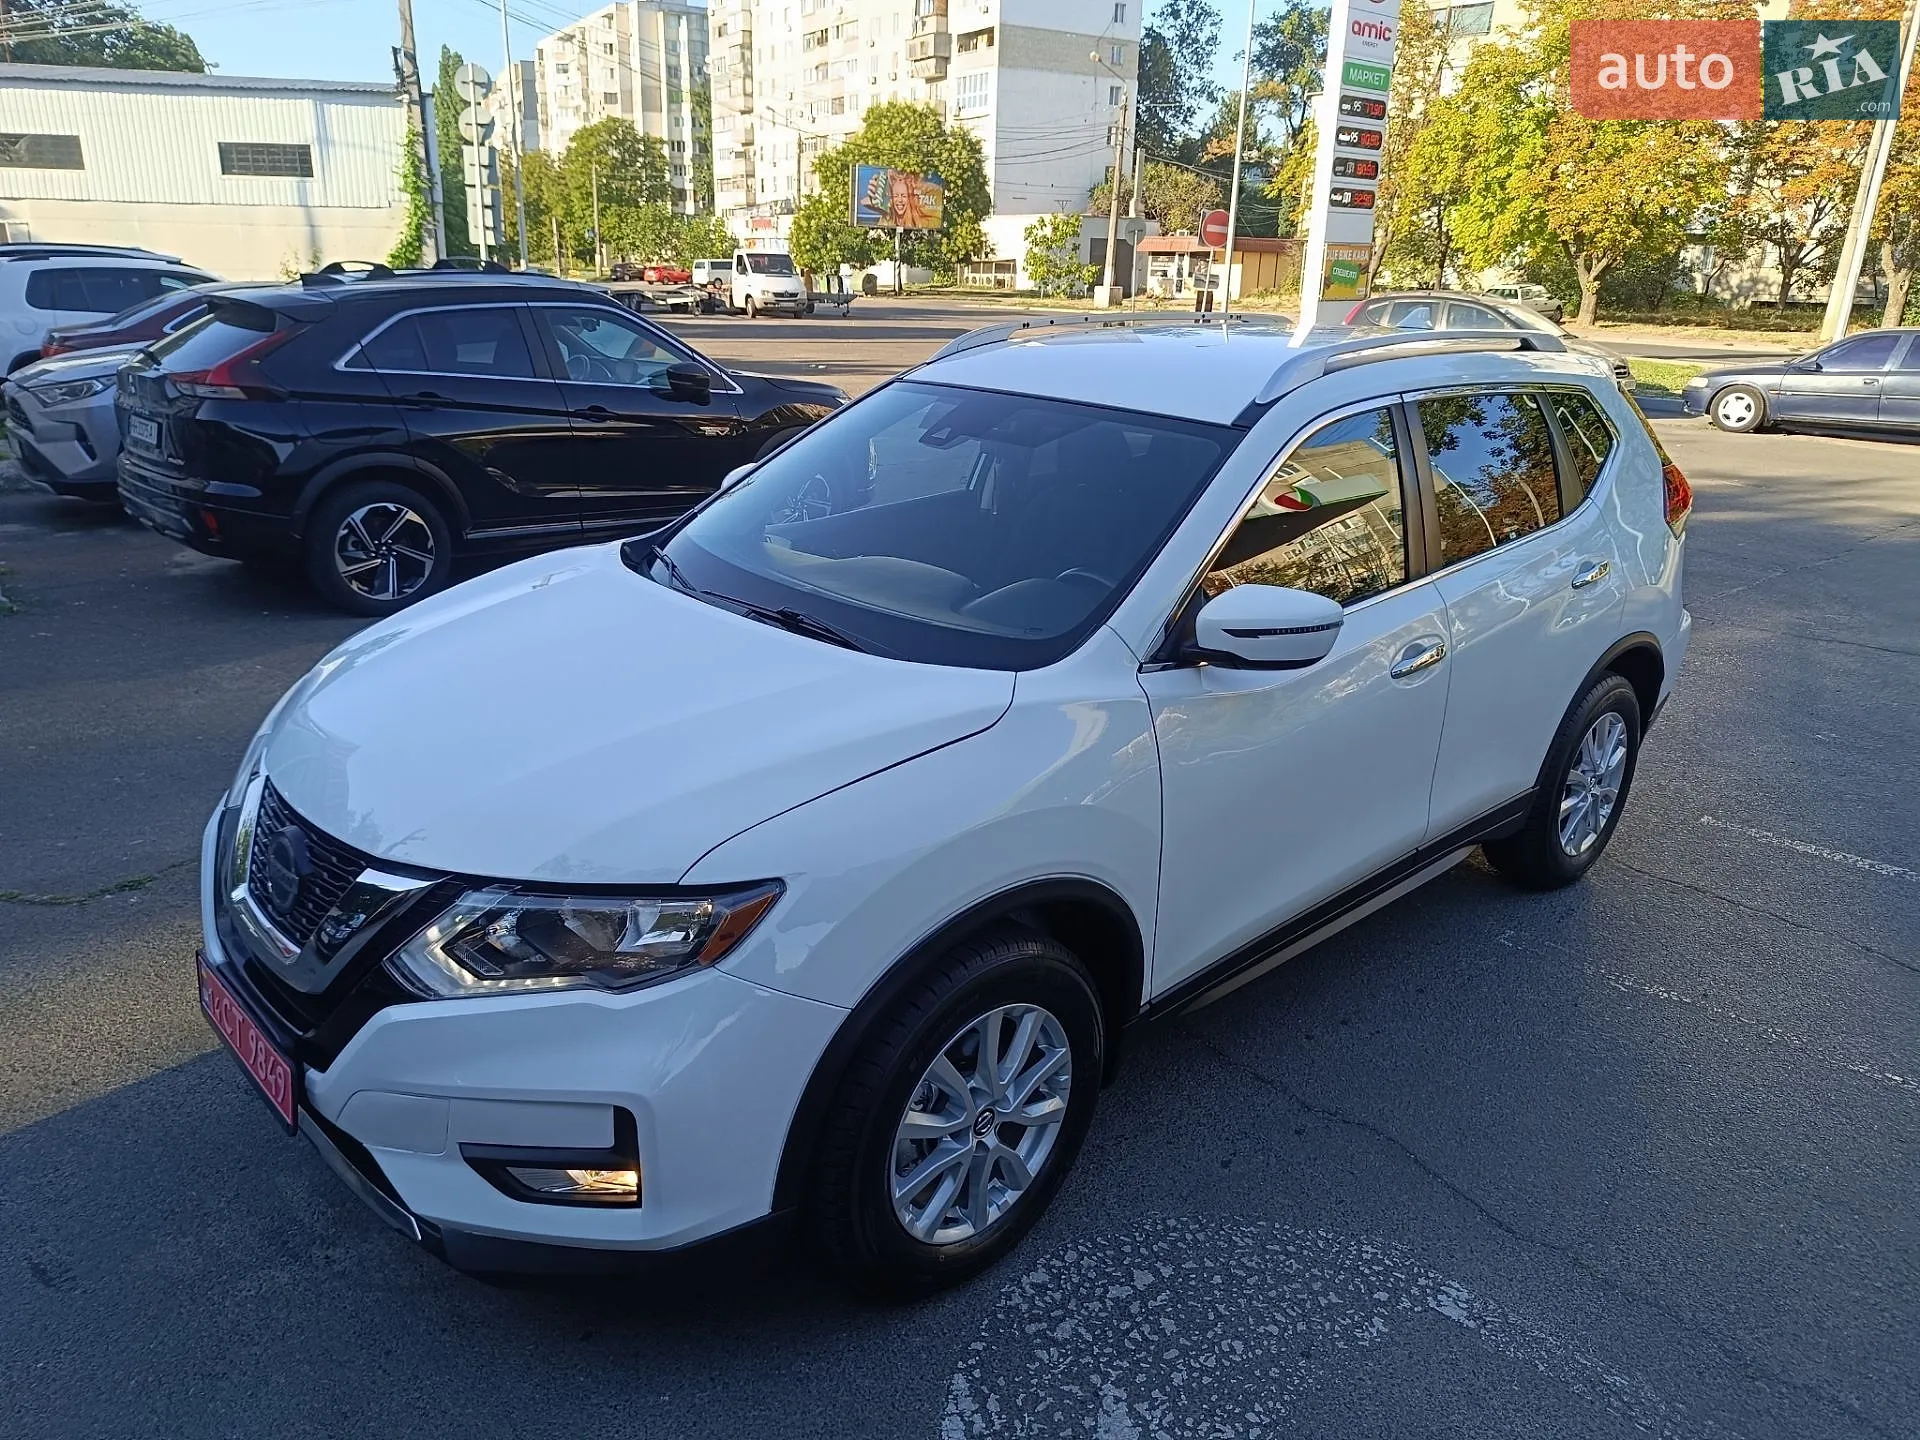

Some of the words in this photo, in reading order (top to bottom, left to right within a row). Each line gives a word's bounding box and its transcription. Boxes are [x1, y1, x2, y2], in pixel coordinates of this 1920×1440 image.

[1351, 20, 1392, 42] amic
[1348, 67, 1386, 86] МАРКЕТ
[1353, 100, 1362, 112] 95
[1350, 131, 1359, 143] 95
[249, 1028, 286, 1103] 9849
